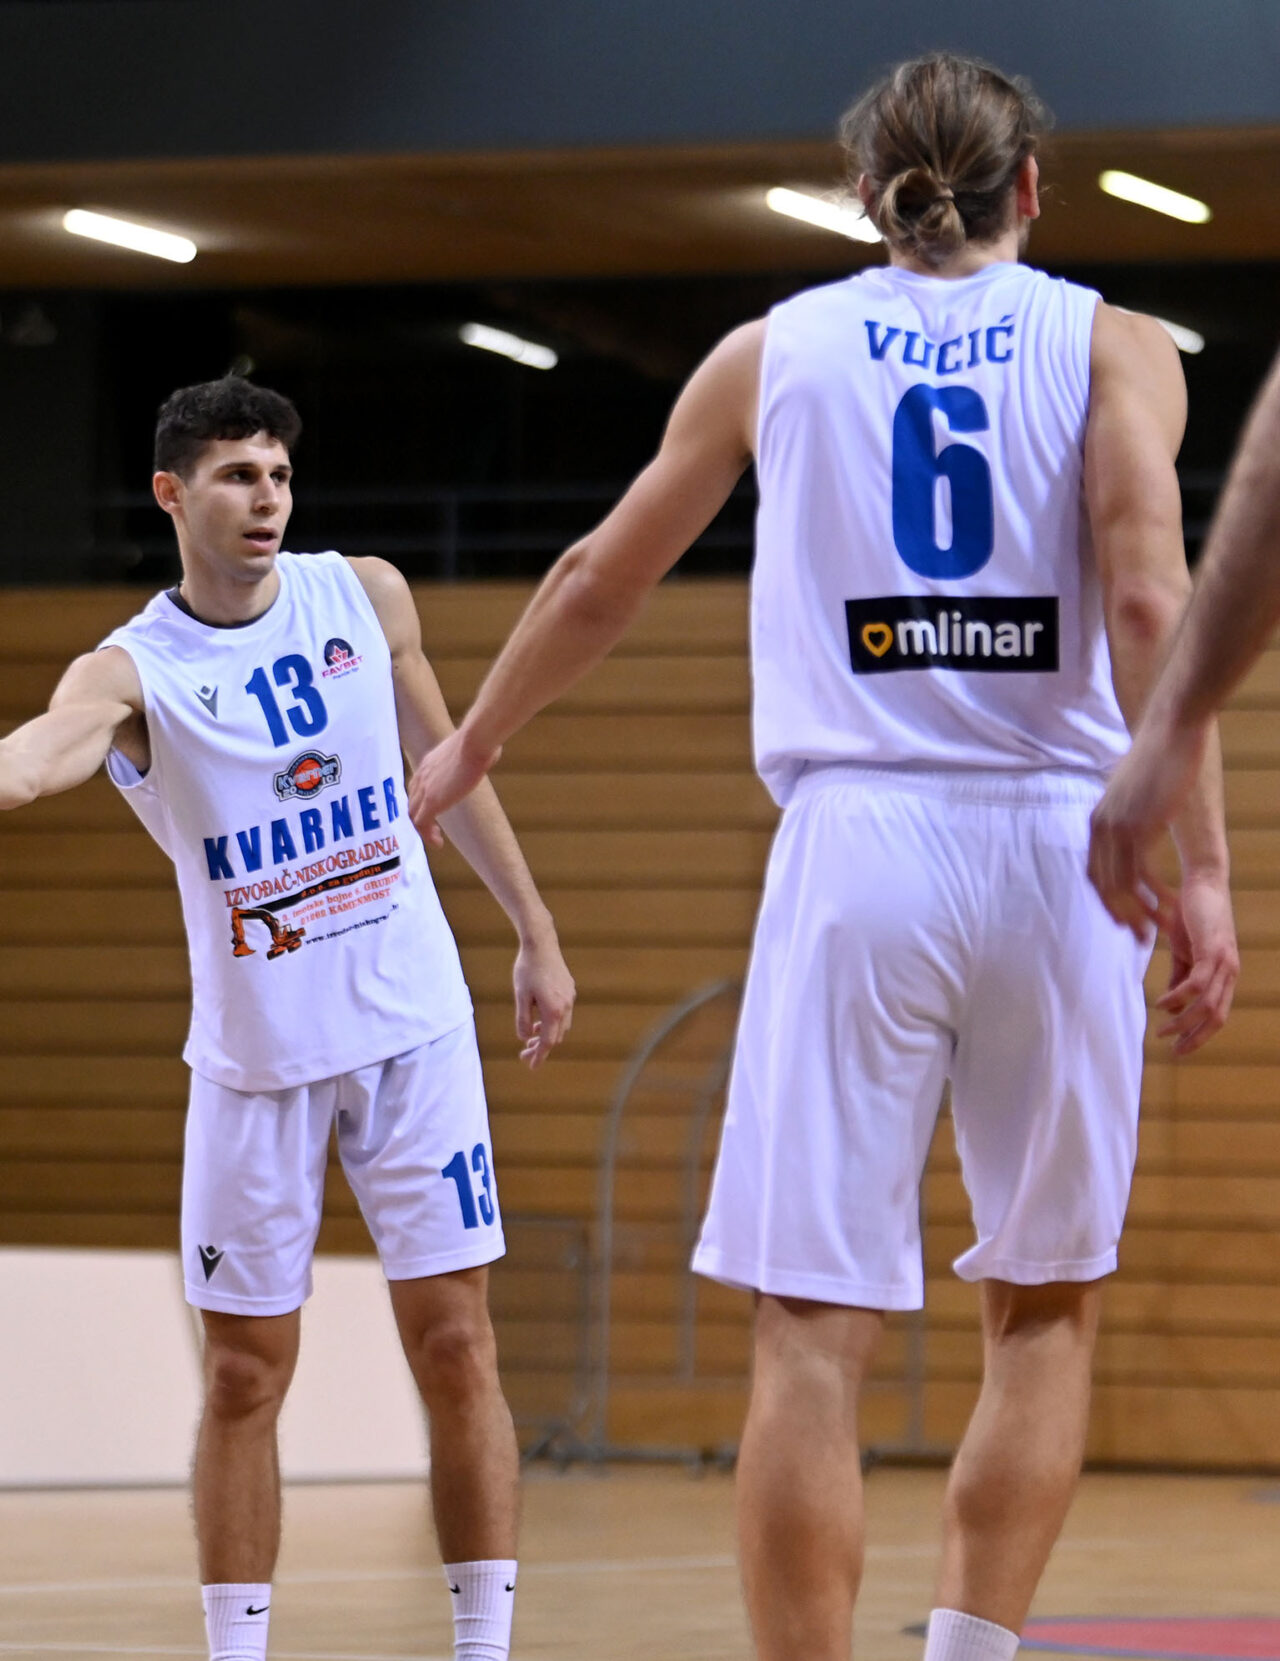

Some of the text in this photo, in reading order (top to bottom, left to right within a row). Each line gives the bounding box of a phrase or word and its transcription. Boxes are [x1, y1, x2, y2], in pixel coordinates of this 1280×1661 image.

[864, 314, 1015, 376] VUCIĆ
[892, 382, 994, 580] 6
[321, 655, 363, 679] FAVBET
[896, 610, 1044, 658] mlinar
[245, 653, 328, 748] 13
[203, 776, 400, 881] KVARNER
[224, 835, 400, 908] IZVOĐAČ-NISKOGRADNJA
[364, 870, 401, 891] GRUBIN
[441, 1142, 495, 1230] 13
